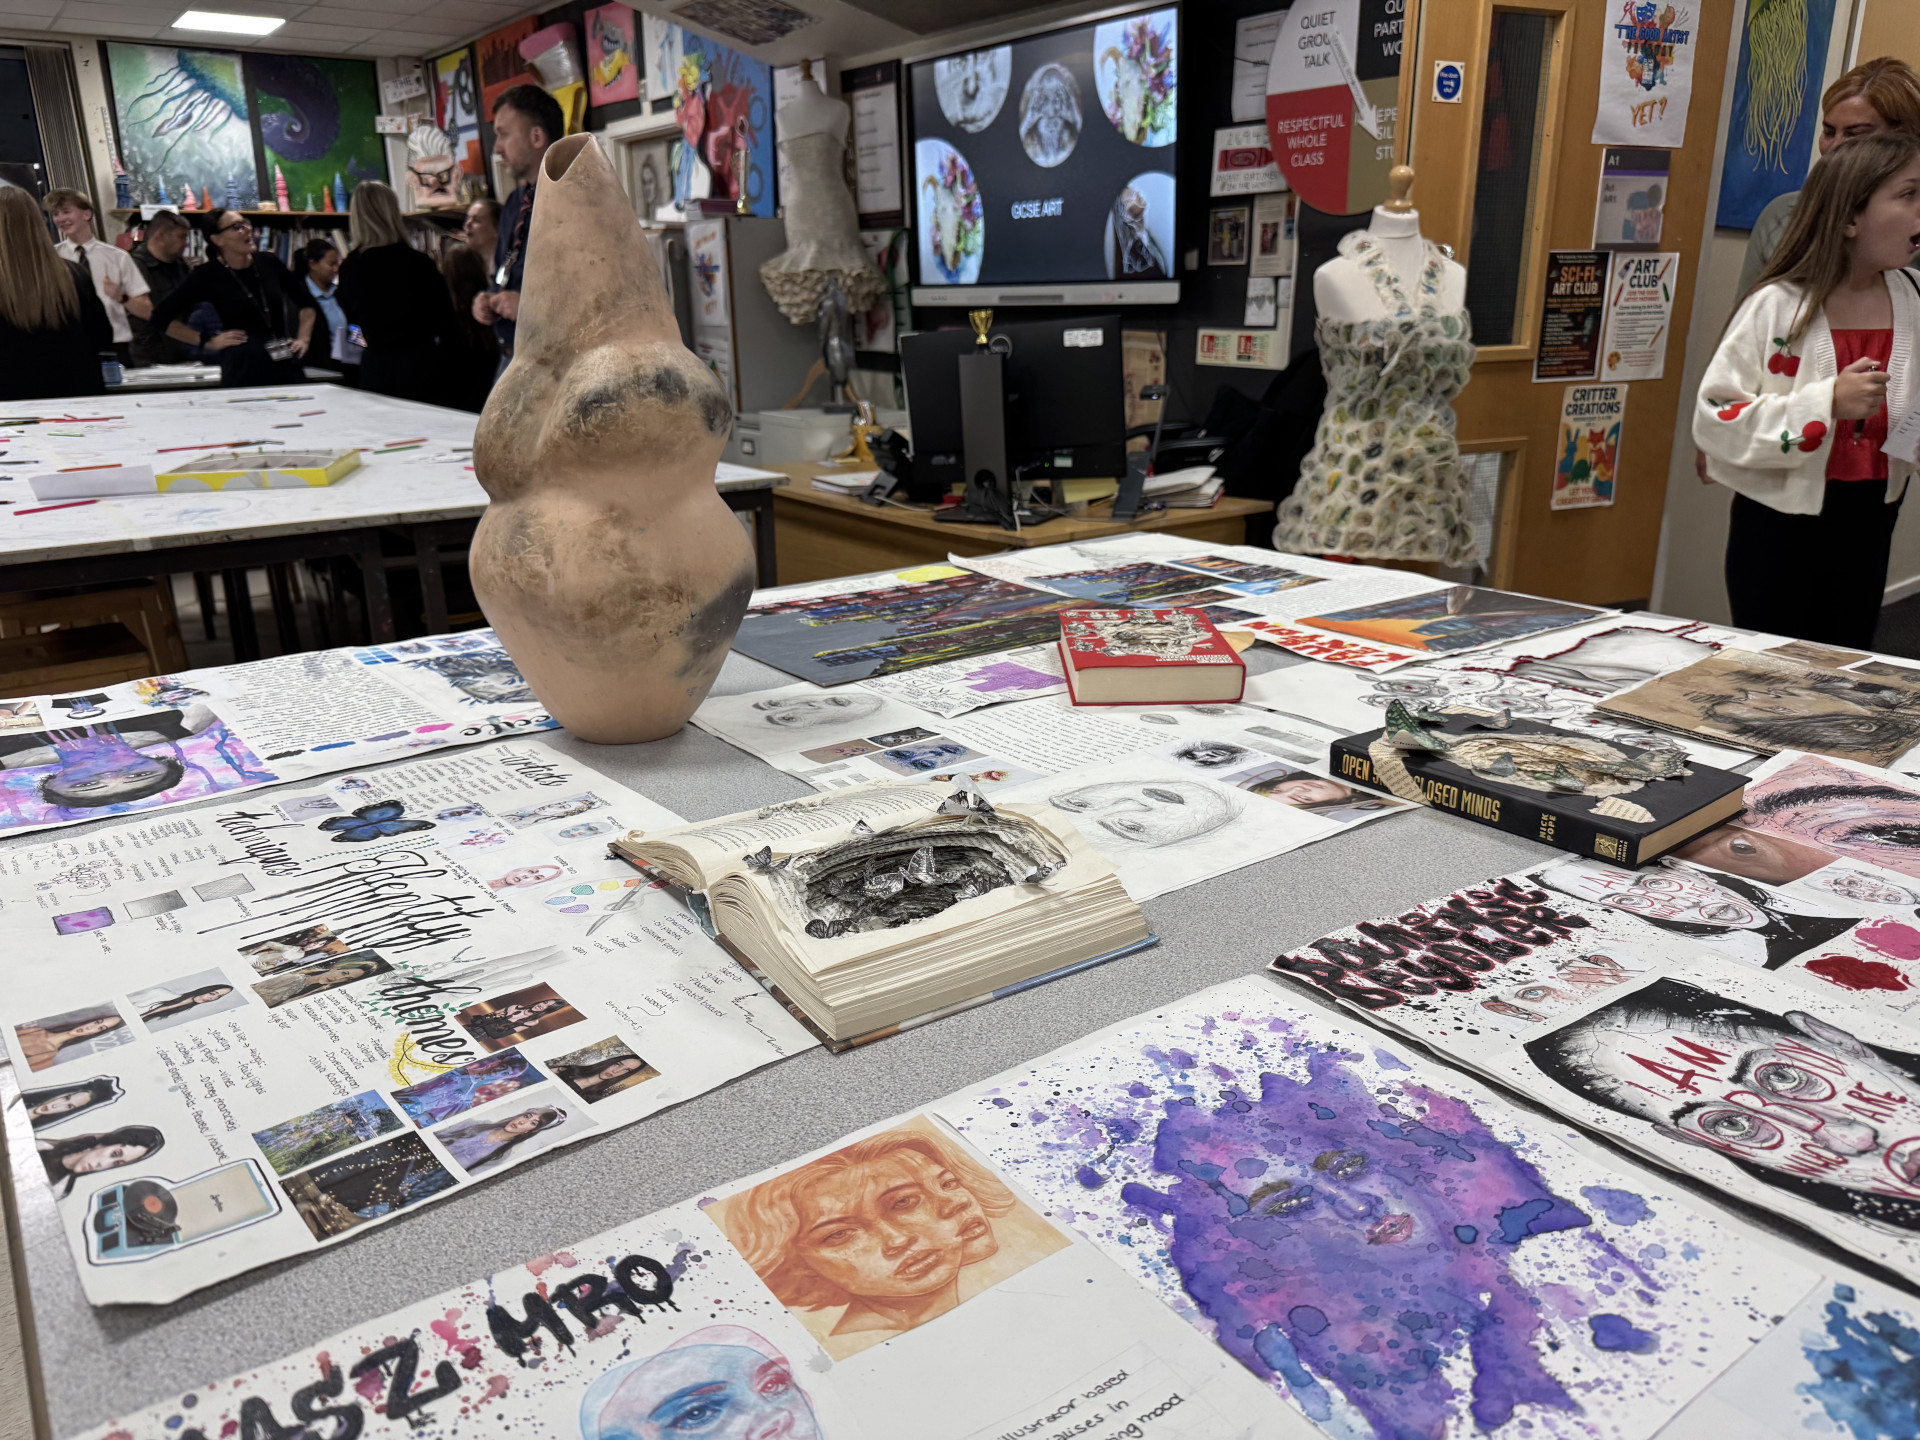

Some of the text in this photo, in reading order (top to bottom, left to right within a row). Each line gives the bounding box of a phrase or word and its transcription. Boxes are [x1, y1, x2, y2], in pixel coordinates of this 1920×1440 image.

[1301, 10, 1336, 29] QUIET
[1614, 24, 1690, 45] THE GOOD ARTIST
[1304, 53, 1331, 69] TALK
[1630, 97, 1668, 127] YET?
[1277, 114, 1345, 134] RESPECTFUL
[1286, 133, 1327, 149] WHOLE
[1290, 152, 1324, 167] CLASS
[1012, 198, 1064, 219] GCSE ART
[1560, 266, 1596, 282] SCI-FI
[1633, 259, 1660, 273] ART
[1552, 281, 1599, 295] ART CLUB
[1629, 275, 1658, 288] CLUB
[1573, 388, 1617, 402] CRITTER
[1566, 402, 1620, 416] CREATIONS
[500, 756, 573, 787] artists
[1342, 753, 1370, 781] OPEN
[1460, 790, 1500, 822] MINDS
[1539, 813, 1549, 839] NICK
[1547, 815, 1557, 842] POPE
[216, 810, 305, 878] techniques
[1584, 869, 1632, 893] AM
[644, 995, 667, 1011] wood
[382, 976, 482, 1066] themes
[606, 1001, 642, 1031] structures
[1626, 1036, 1735, 1095] AM
[1774, 1142, 1850, 1177] WHO
[1842, 1081, 1908, 1124] ARE
[1081, 1369, 1130, 1400] based
[1107, 1400, 1130, 1414] in
[1136, 1392, 1186, 1424] mood
